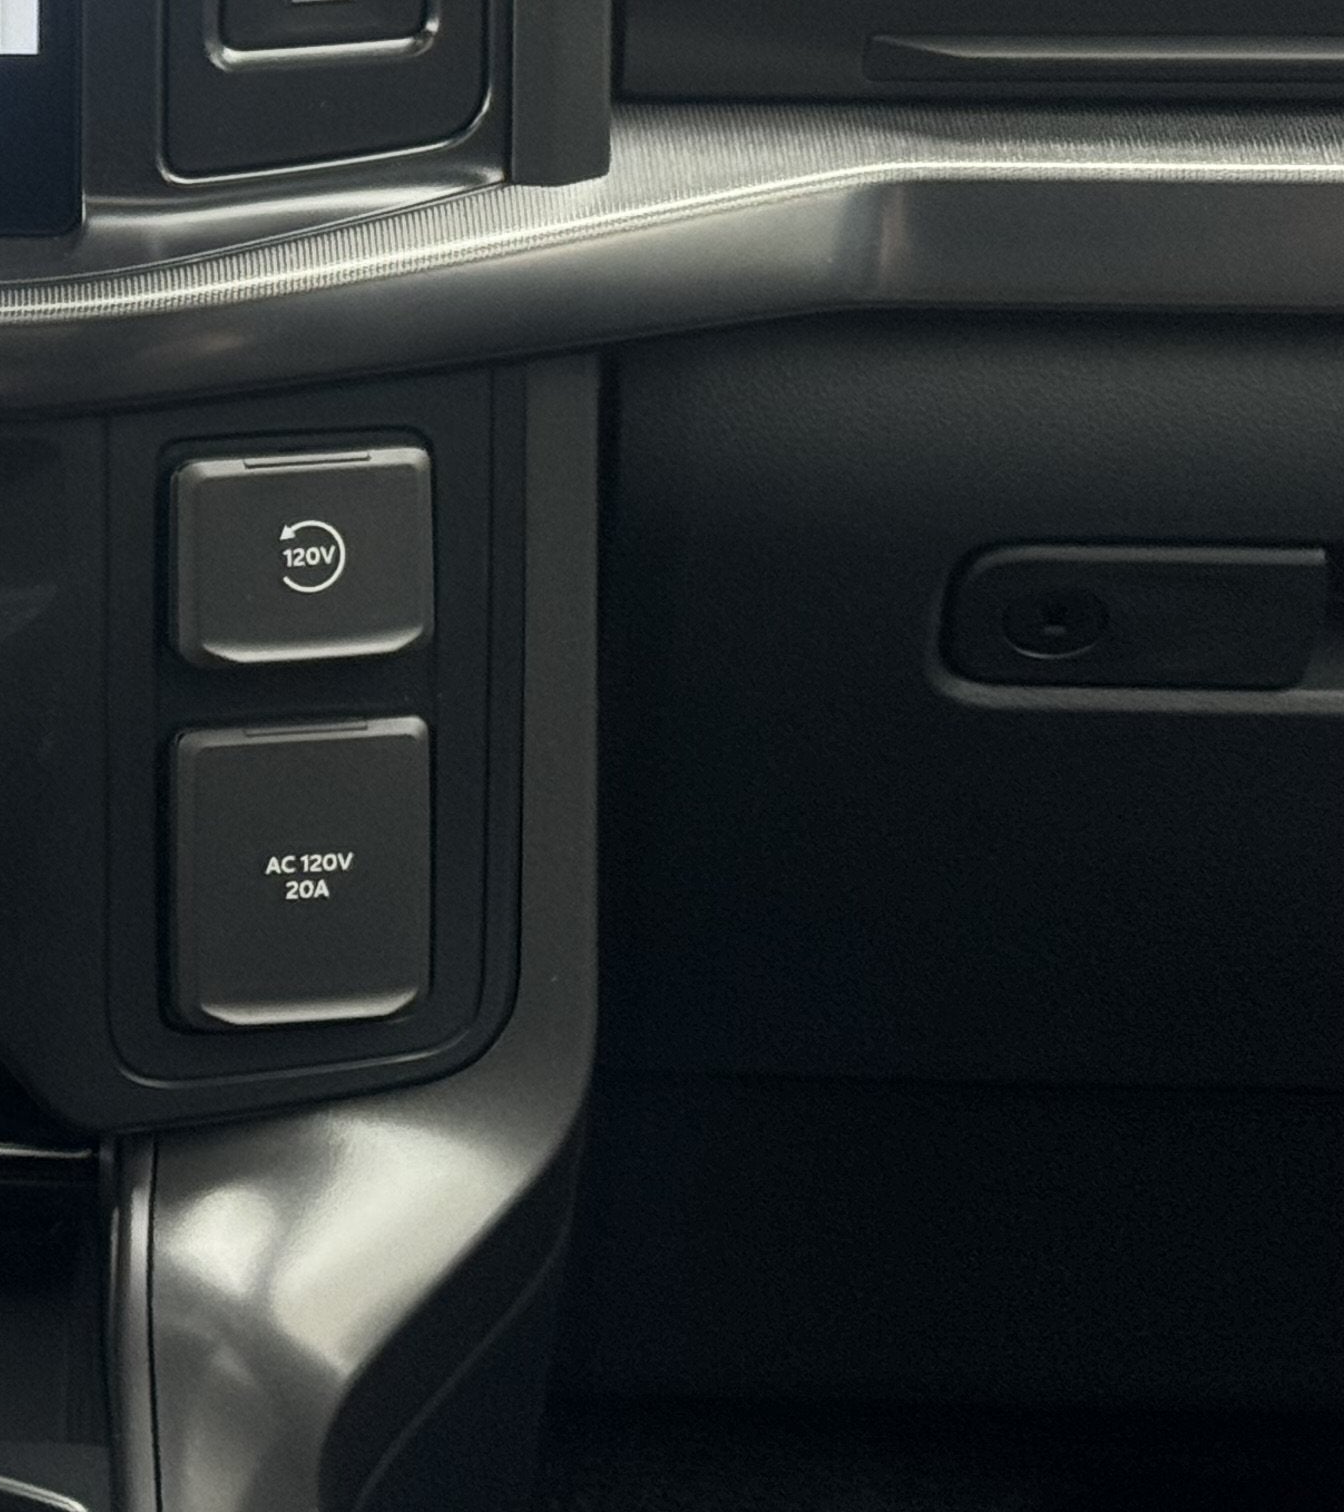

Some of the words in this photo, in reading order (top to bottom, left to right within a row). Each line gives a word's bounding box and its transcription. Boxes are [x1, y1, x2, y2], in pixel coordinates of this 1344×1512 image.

[283, 545, 336, 568] 120V
[265, 855, 296, 876] AC
[300, 851, 355, 874] 120V
[285, 879, 330, 900] 20A
